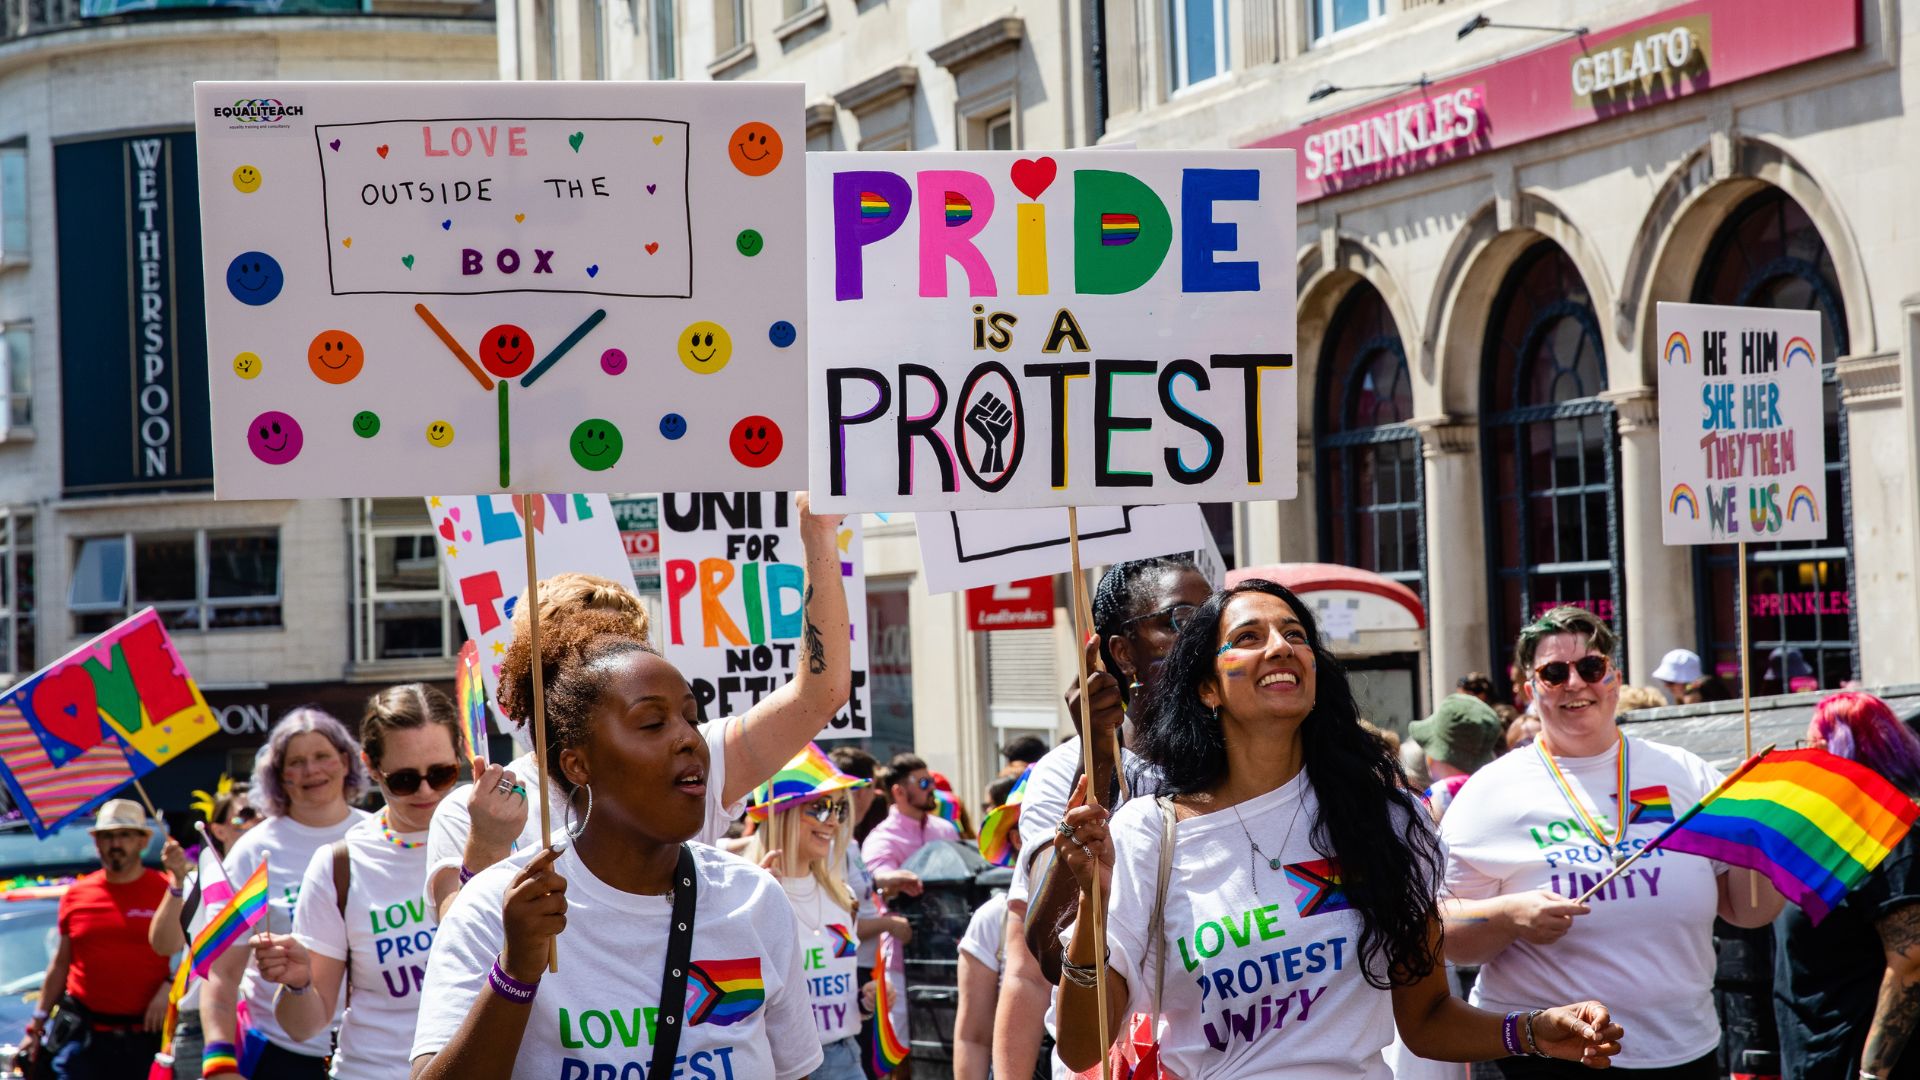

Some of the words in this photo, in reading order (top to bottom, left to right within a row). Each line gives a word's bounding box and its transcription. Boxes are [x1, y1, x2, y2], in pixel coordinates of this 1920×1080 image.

[1571, 27, 1692, 97] GELATO
[214, 105, 303, 118] EQUALITEACH
[1303, 87, 1478, 180] SPRINKLES
[423, 126, 528, 157] LOVE
[362, 179, 492, 206] OUTSIDE
[544, 177, 610, 198] THE
[462, 248, 555, 275] BOX
[131, 138, 171, 477] WETHERSPOON
[1042, 308, 1091, 354] A
[1702, 330, 1727, 376] HE
[1741, 330, 1779, 375] HIM
[826, 354, 1294, 496] PROTEST
[1701, 383, 1736, 430] SHE
[1743, 382, 1783, 430] HER
[663, 492, 789, 533] UNIT
[1706, 483, 1739, 539] WE
[1750, 482, 1783, 533] US
[727, 534, 780, 562] FOR
[666, 557, 853, 648] PRID
[727, 643, 796, 673] NOT
[369, 896, 425, 935] LOV
[1176, 903, 1286, 973] LOVE
[1196, 936, 1347, 1014] PROTEST
